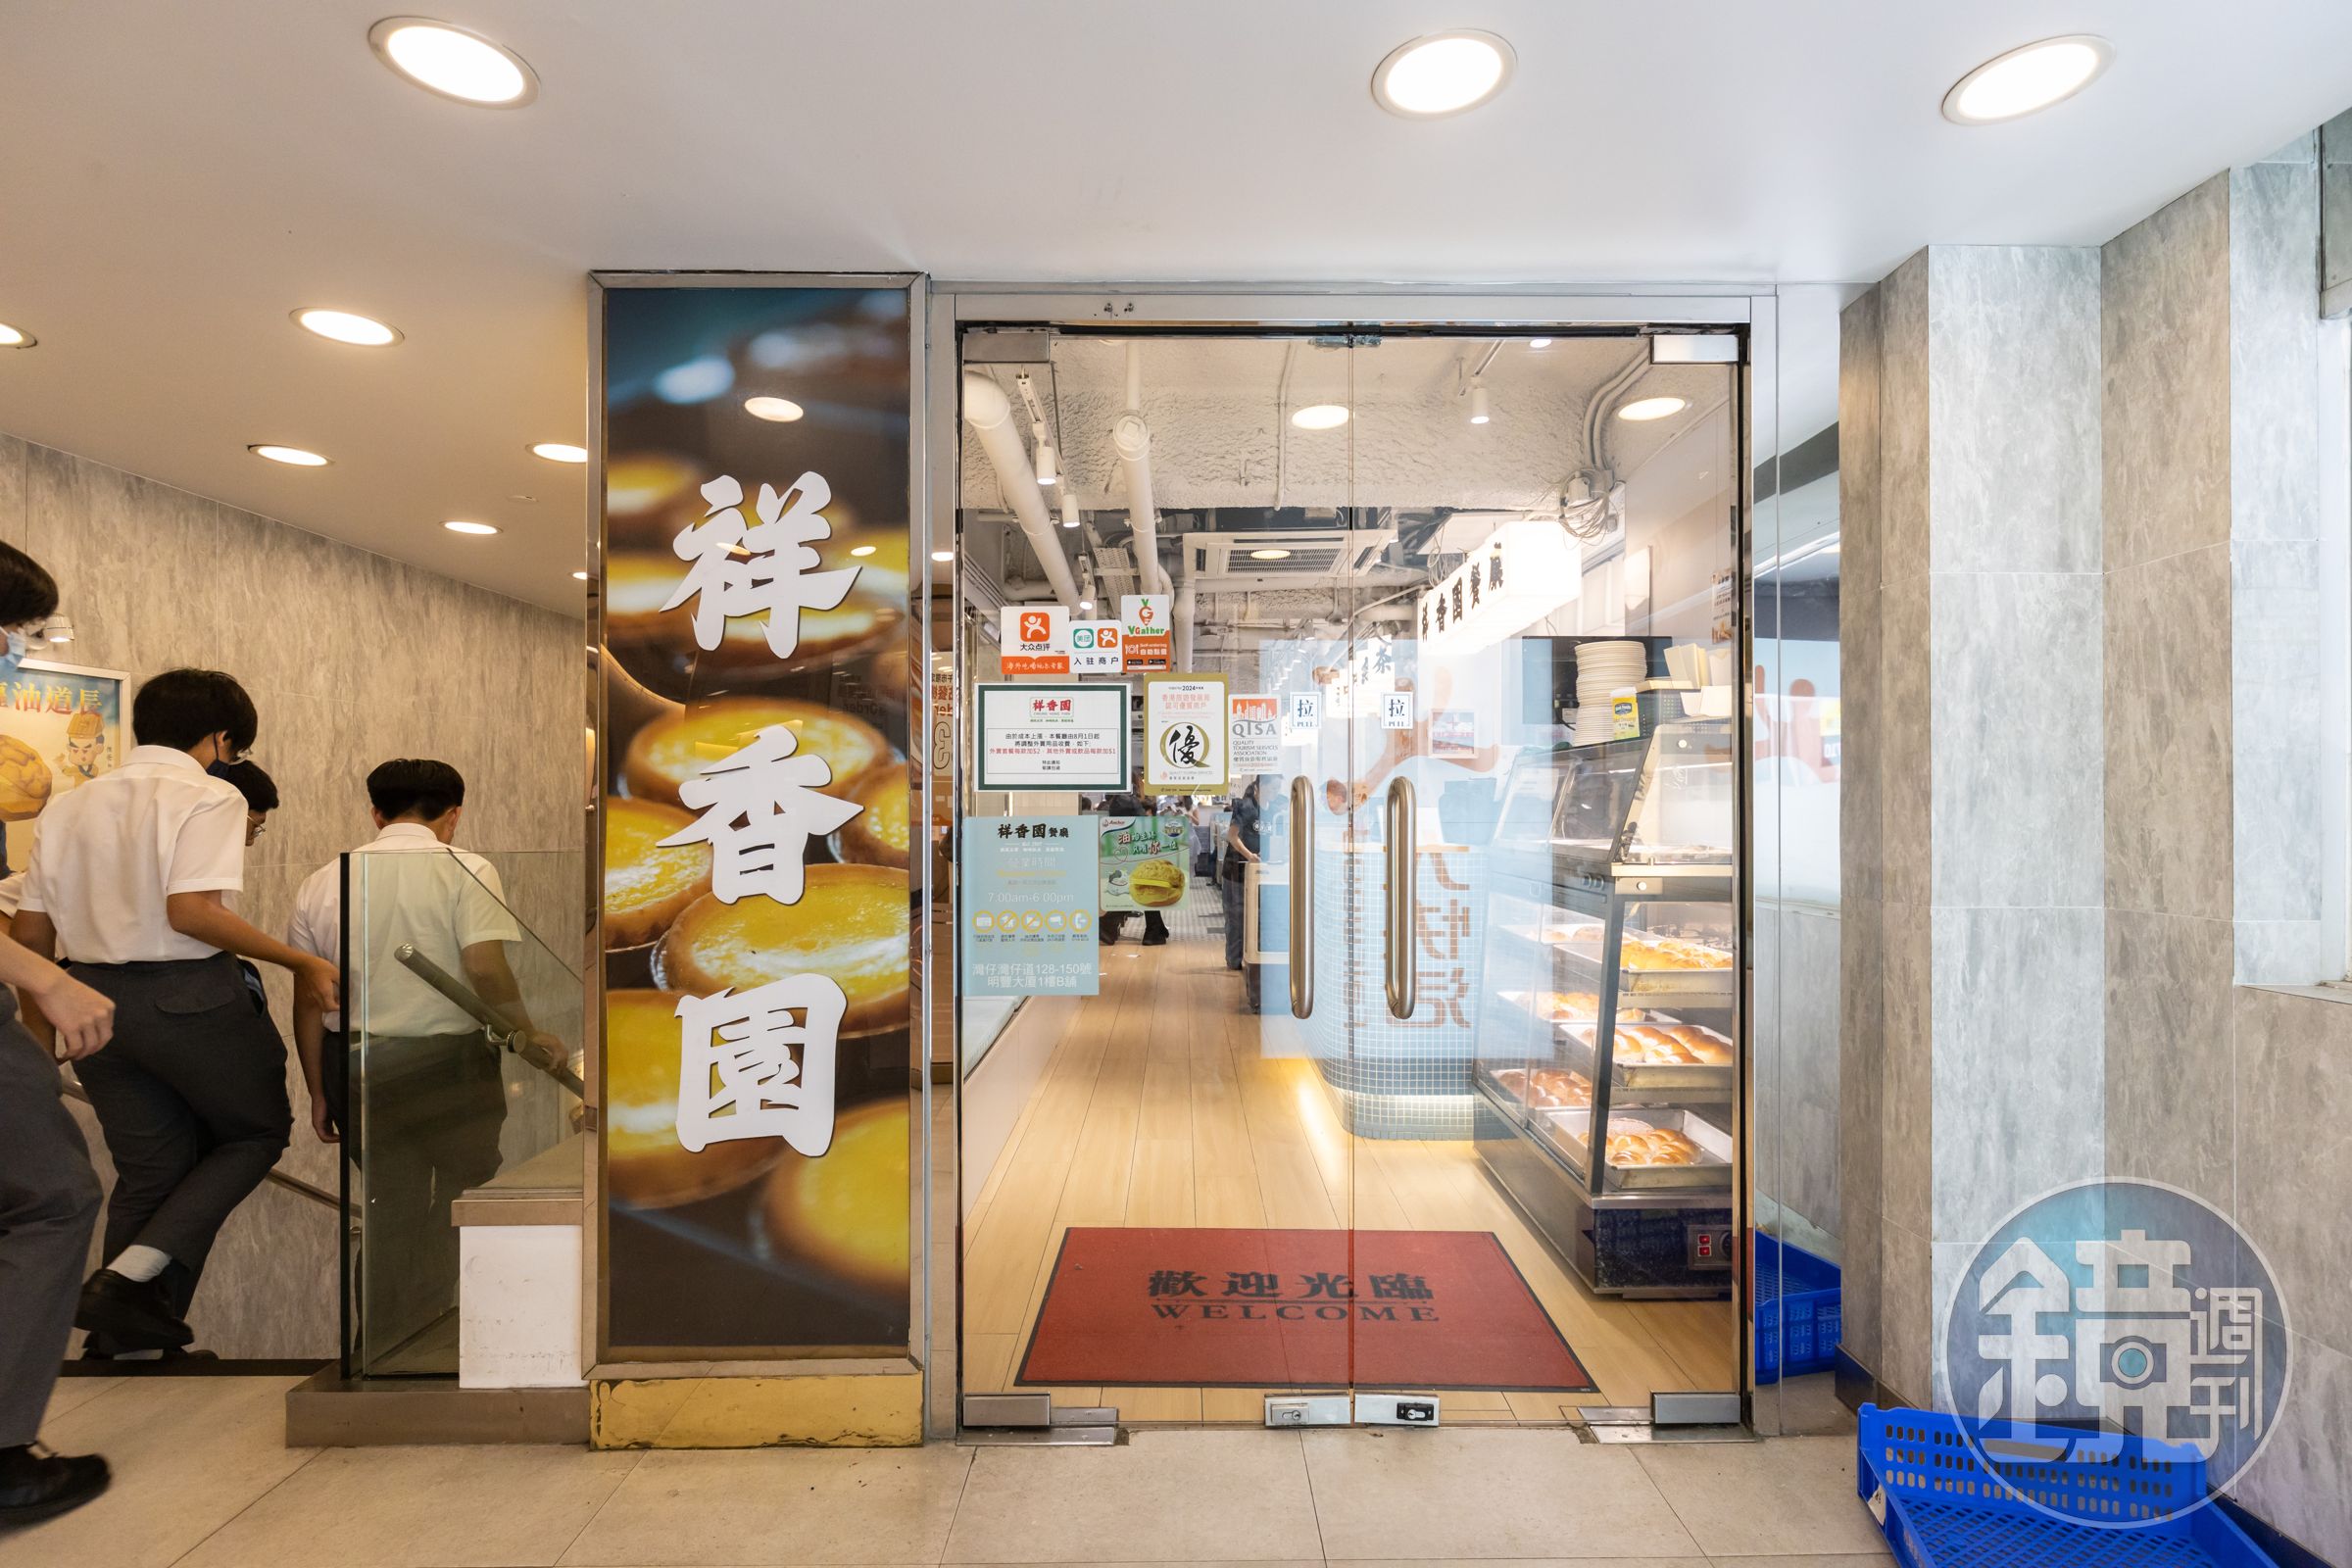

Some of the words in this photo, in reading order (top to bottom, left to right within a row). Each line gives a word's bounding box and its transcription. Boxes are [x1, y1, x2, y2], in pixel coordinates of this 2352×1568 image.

[1127, 625, 1164, 635] VGather
[1020, 643, 1051, 652] 大众点评
[1074, 657, 1119, 665] 入驻商户
[0, 682, 102, 714] 油道長
[1033, 699, 1071, 711] 祥香園
[1298, 699, 1313, 717] 拉
[1389, 699, 1405, 717] 拉
[1232, 720, 1277, 737] QTSA
[656, 470, 865, 1157] 祥香園
[1147, 1270, 1435, 1300] 歡迎光臨
[1151, 1303, 1440, 1322] WELCOME
